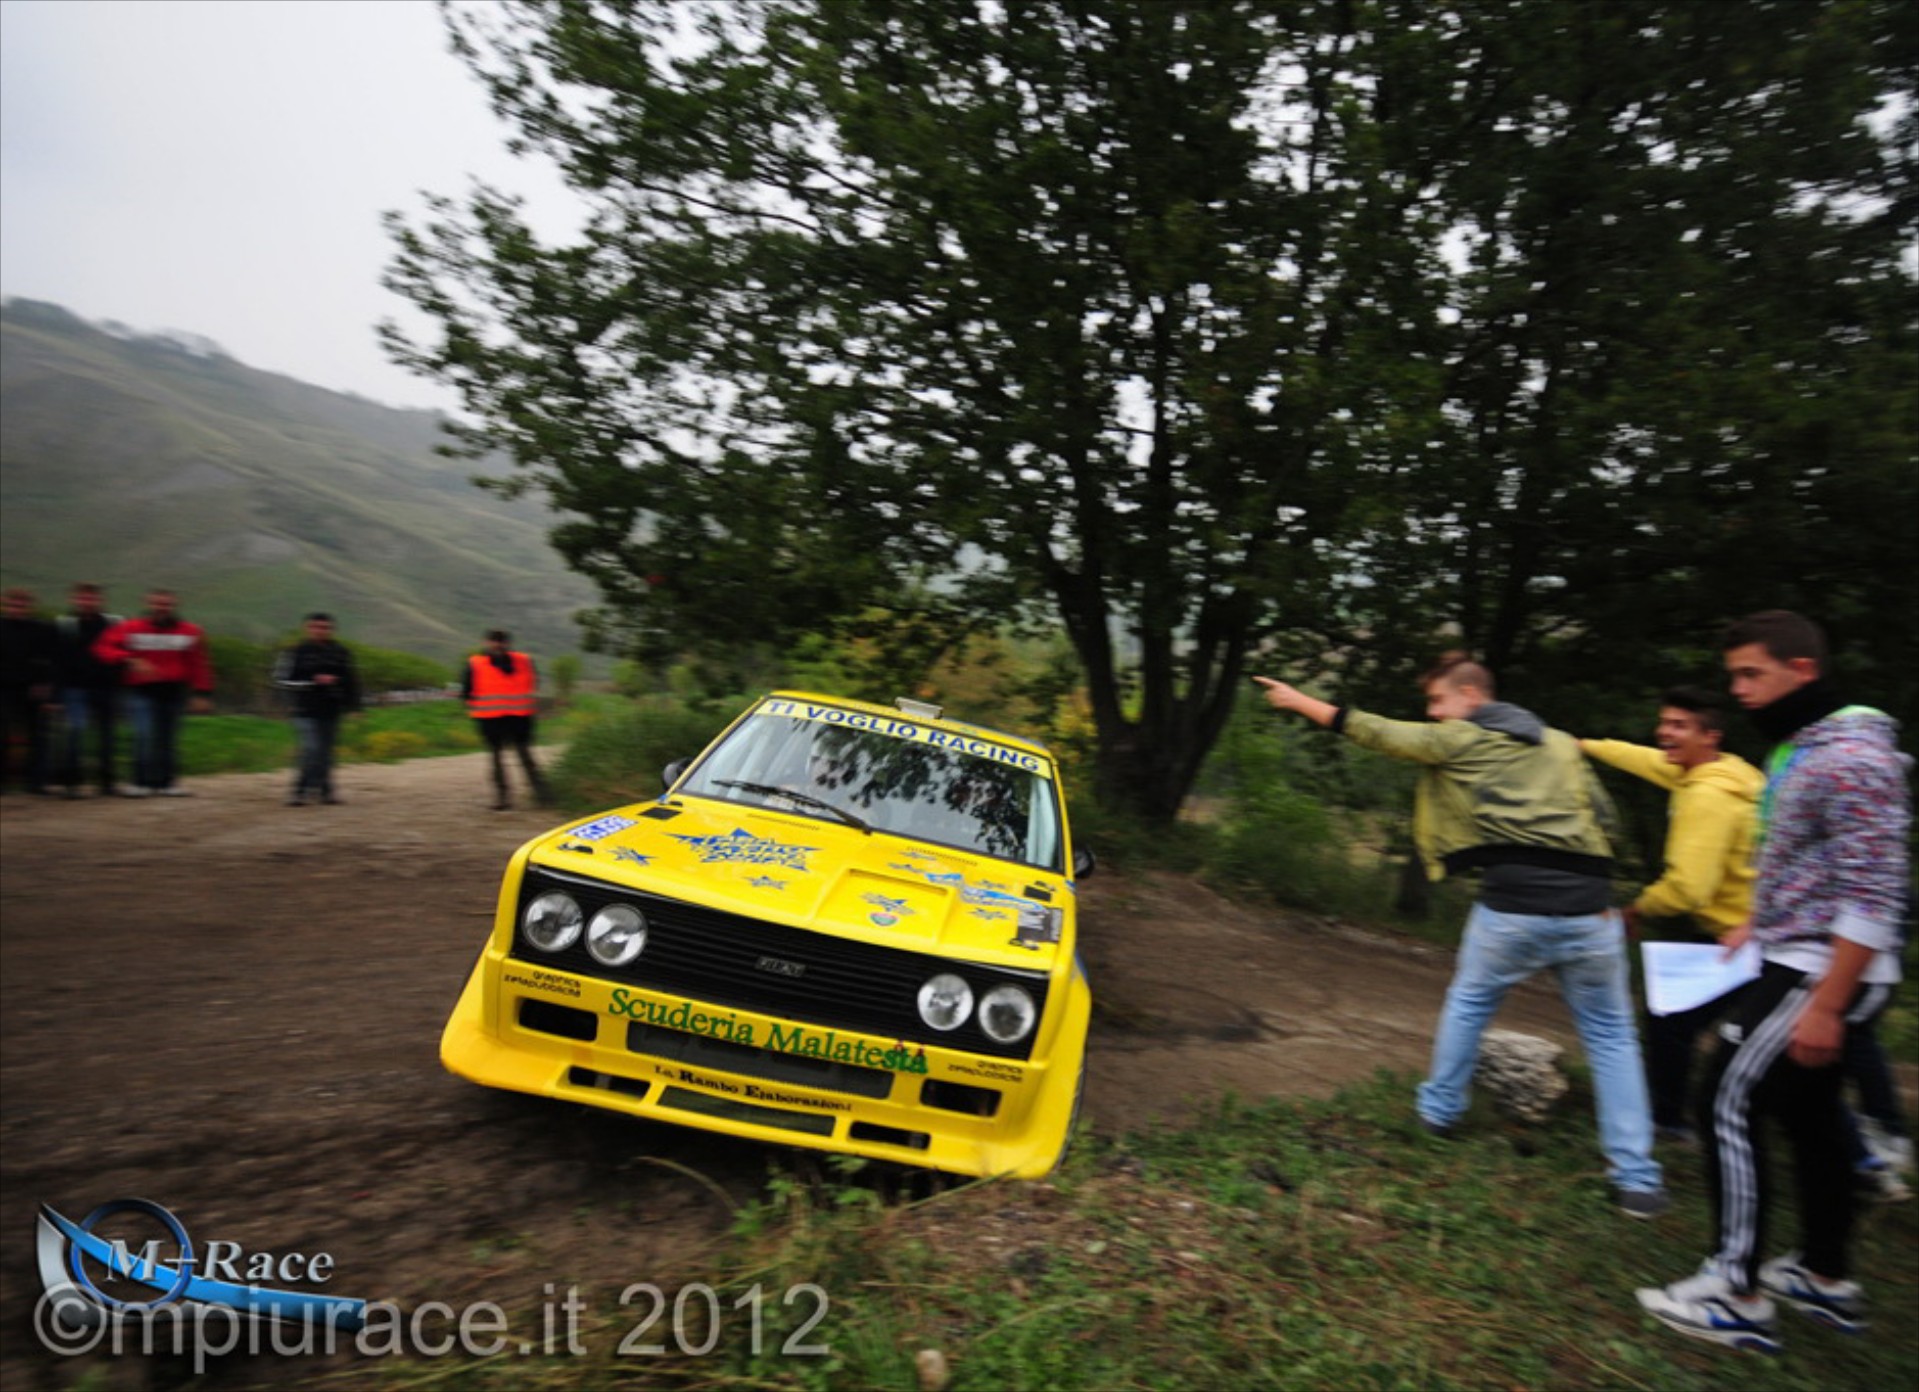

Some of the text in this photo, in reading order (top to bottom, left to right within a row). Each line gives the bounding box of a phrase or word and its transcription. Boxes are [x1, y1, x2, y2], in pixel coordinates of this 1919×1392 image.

[768, 701, 1040, 772] TI VOGLIO RACING
[608, 988, 928, 1075] Scuderia Malatesta
[679, 1069, 739, 1094] Rambo
